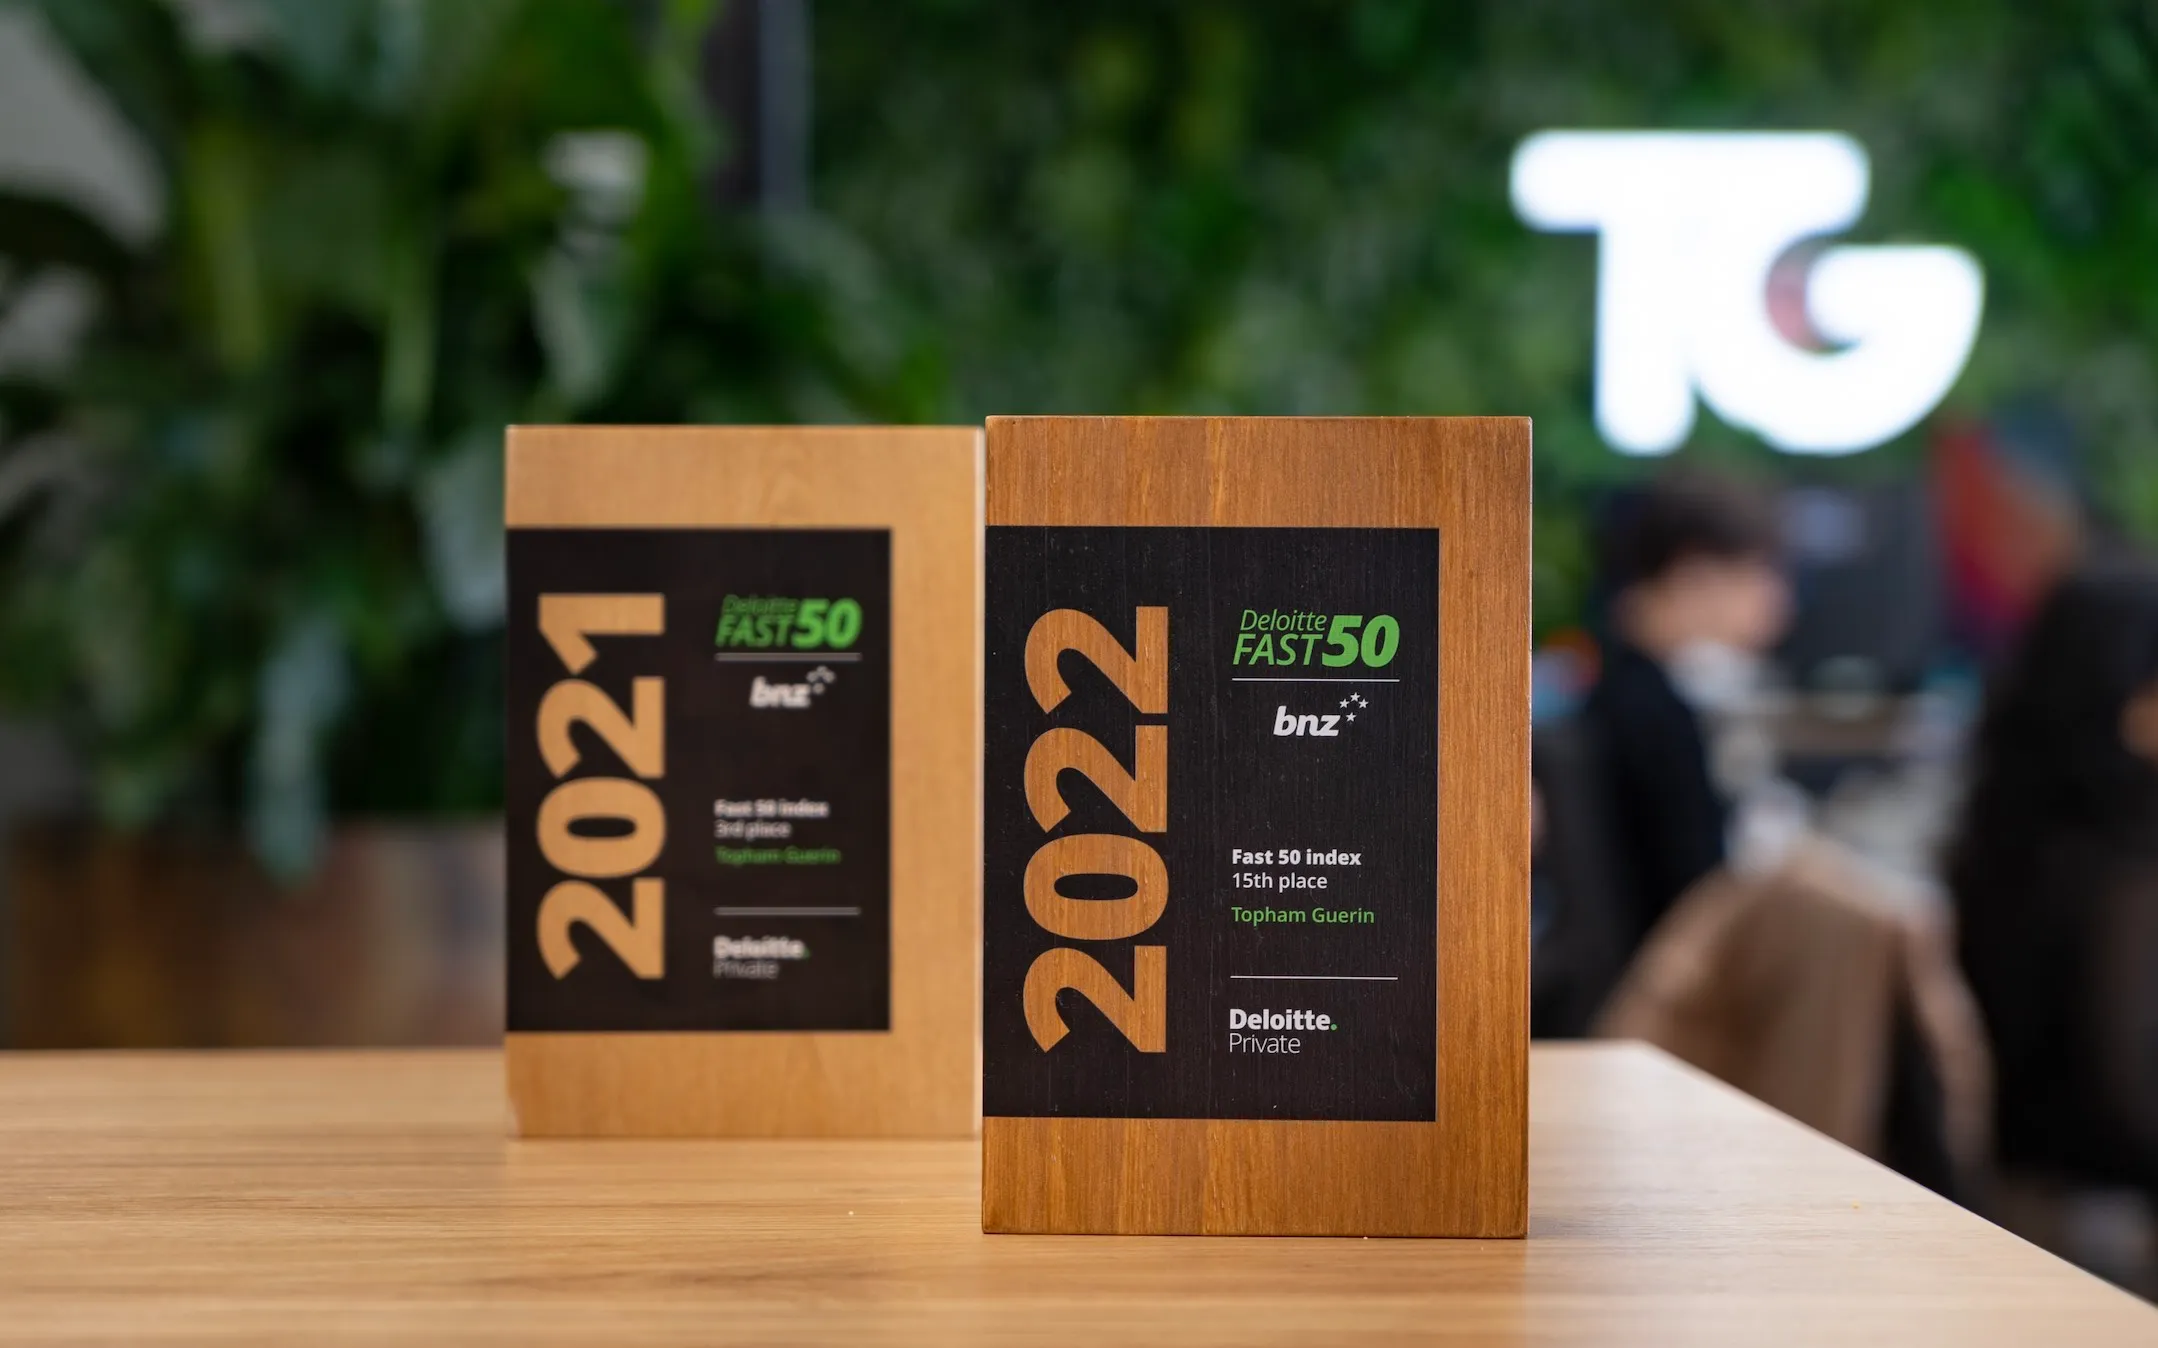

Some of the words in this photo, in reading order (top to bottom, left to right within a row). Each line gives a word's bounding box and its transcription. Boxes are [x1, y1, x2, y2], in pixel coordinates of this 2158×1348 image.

[1511, 131, 1983, 455] TG
[1240, 609, 1327, 631] Deloitte
[750, 676, 811, 708] bnz
[1273, 705, 1341, 737] bnz
[536, 592, 666, 980] 2021
[1023, 606, 1168, 1053] 2022
[1232, 849, 1274, 865] Fast
[1279, 849, 1302, 865] 50
[1306, 848, 1361, 865] index
[1232, 872, 1273, 889] 15th
[1278, 873, 1328, 894] place
[1231, 906, 1306, 927] Topham
[1311, 907, 1375, 924] Guerin
[1230, 1033, 1301, 1054] Private
